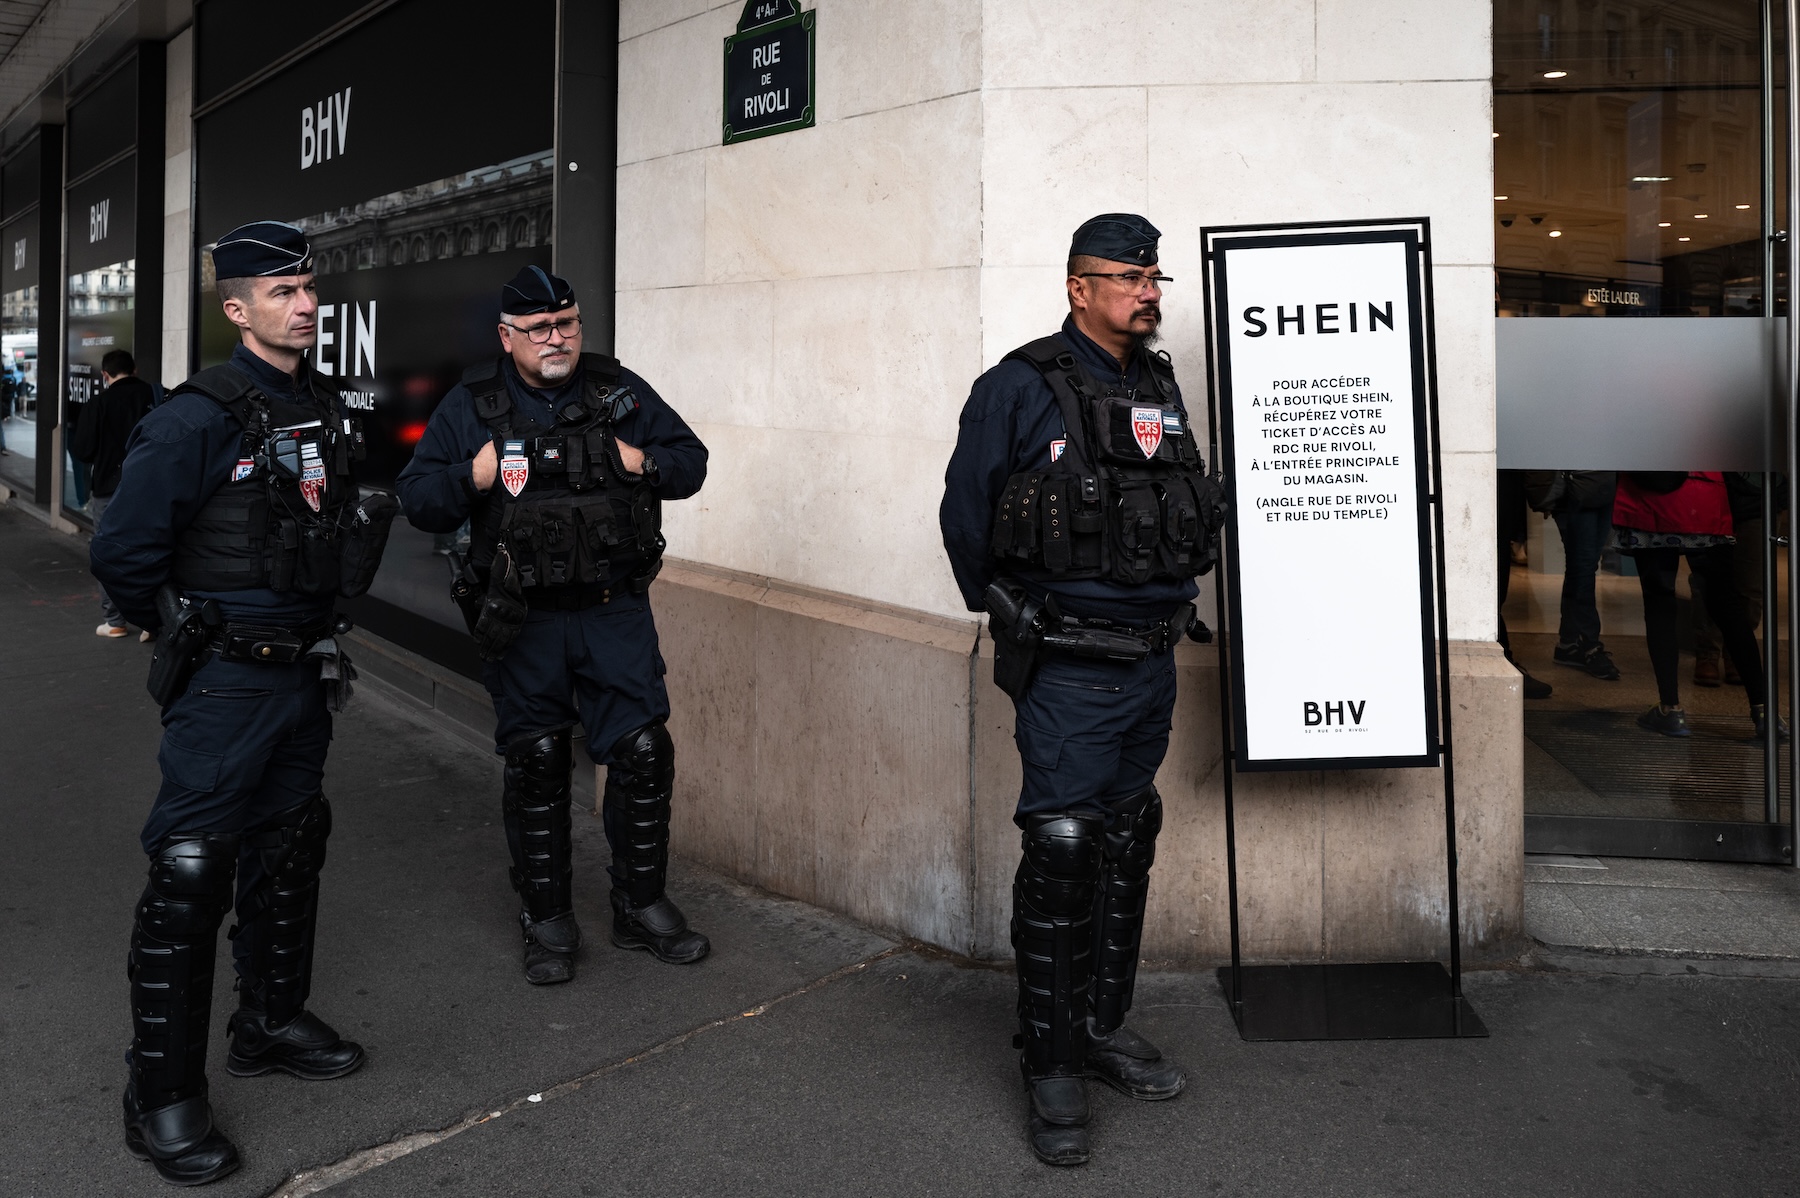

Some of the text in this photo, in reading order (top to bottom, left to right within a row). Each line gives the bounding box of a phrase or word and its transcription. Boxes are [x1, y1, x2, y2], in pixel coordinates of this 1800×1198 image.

[752, 41, 781, 69] RUE
[761, 73, 772, 86] DE
[744, 88, 790, 119] RIVOLI
[300, 86, 353, 170] BHV
[90, 199, 110, 244] BHV
[1587, 287, 1640, 305] ESTÉE LAUDER
[1243, 301, 1395, 338] SHEIN
[316, 300, 377, 379] EIN
[69, 376, 92, 404] SHEIN
[1273, 376, 1371, 390] POUR ACCÉDER
[340, 390, 375, 411] ONDIALE
[1252, 392, 1394, 407] À LA BOUTIQUE SHEIN,
[1264, 409, 1382, 423] RÉCUPÉREZ VOTRE
[1137, 422, 1159, 435] CRS
[1262, 428, 1306, 438] TICKET
[1369, 425, 1386, 435] AU
[1273, 441, 1376, 454] RDC RUE RIVOLI,
[1251, 459, 1260, 471] À
[1325, 456, 1400, 468] PRINCIPALE
[505, 470, 525, 480] CRS
[1283, 474, 1368, 486] DU MAGASIN.
[303, 479, 323, 492] CRS
[1256, 494, 1397, 509] (ANGLE RUE DE RIVOLI
[1266, 508, 1388, 522] ET RUE DU TEMPLE)
[1304, 700, 1366, 726] BHV
